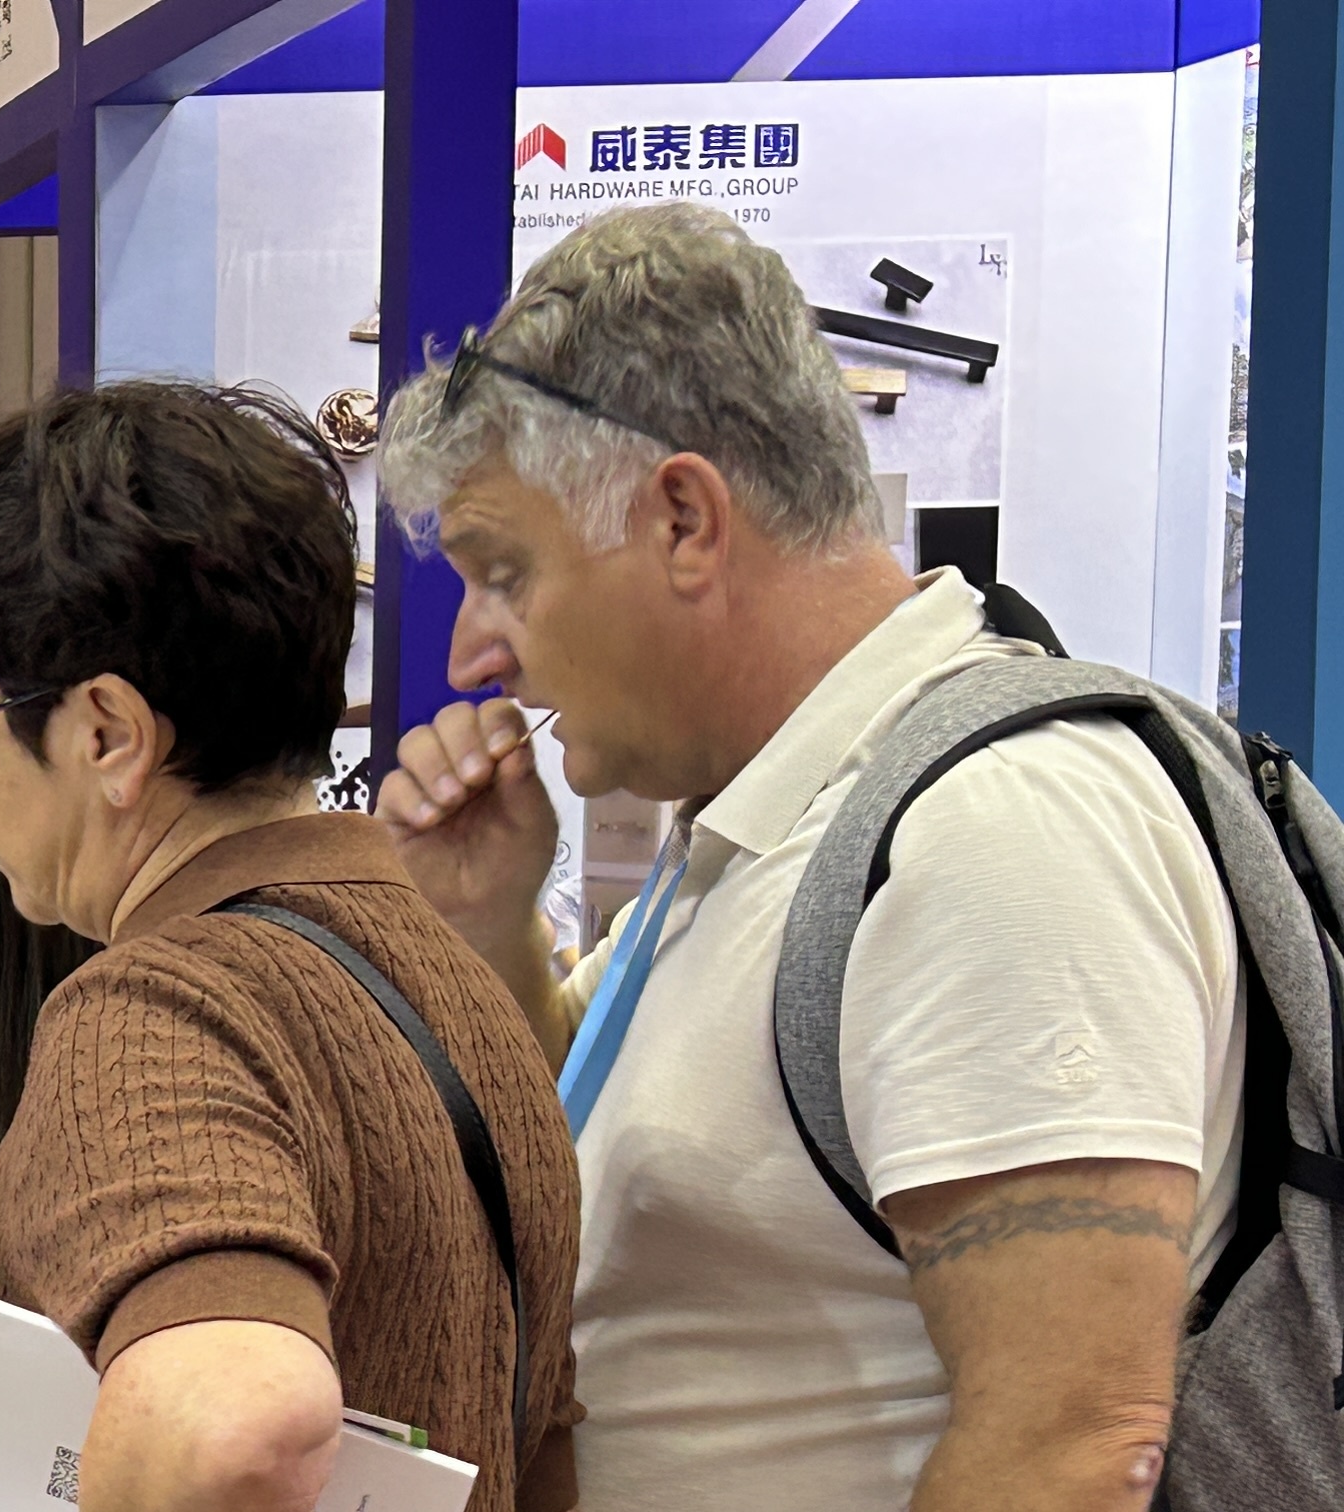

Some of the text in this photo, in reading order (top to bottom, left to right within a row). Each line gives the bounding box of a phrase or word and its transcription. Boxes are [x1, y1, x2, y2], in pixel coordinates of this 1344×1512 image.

[589, 123, 799, 172] 威泰集團
[550, 179, 663, 200] HARDWARE
[733, 207, 771, 223] 1970
